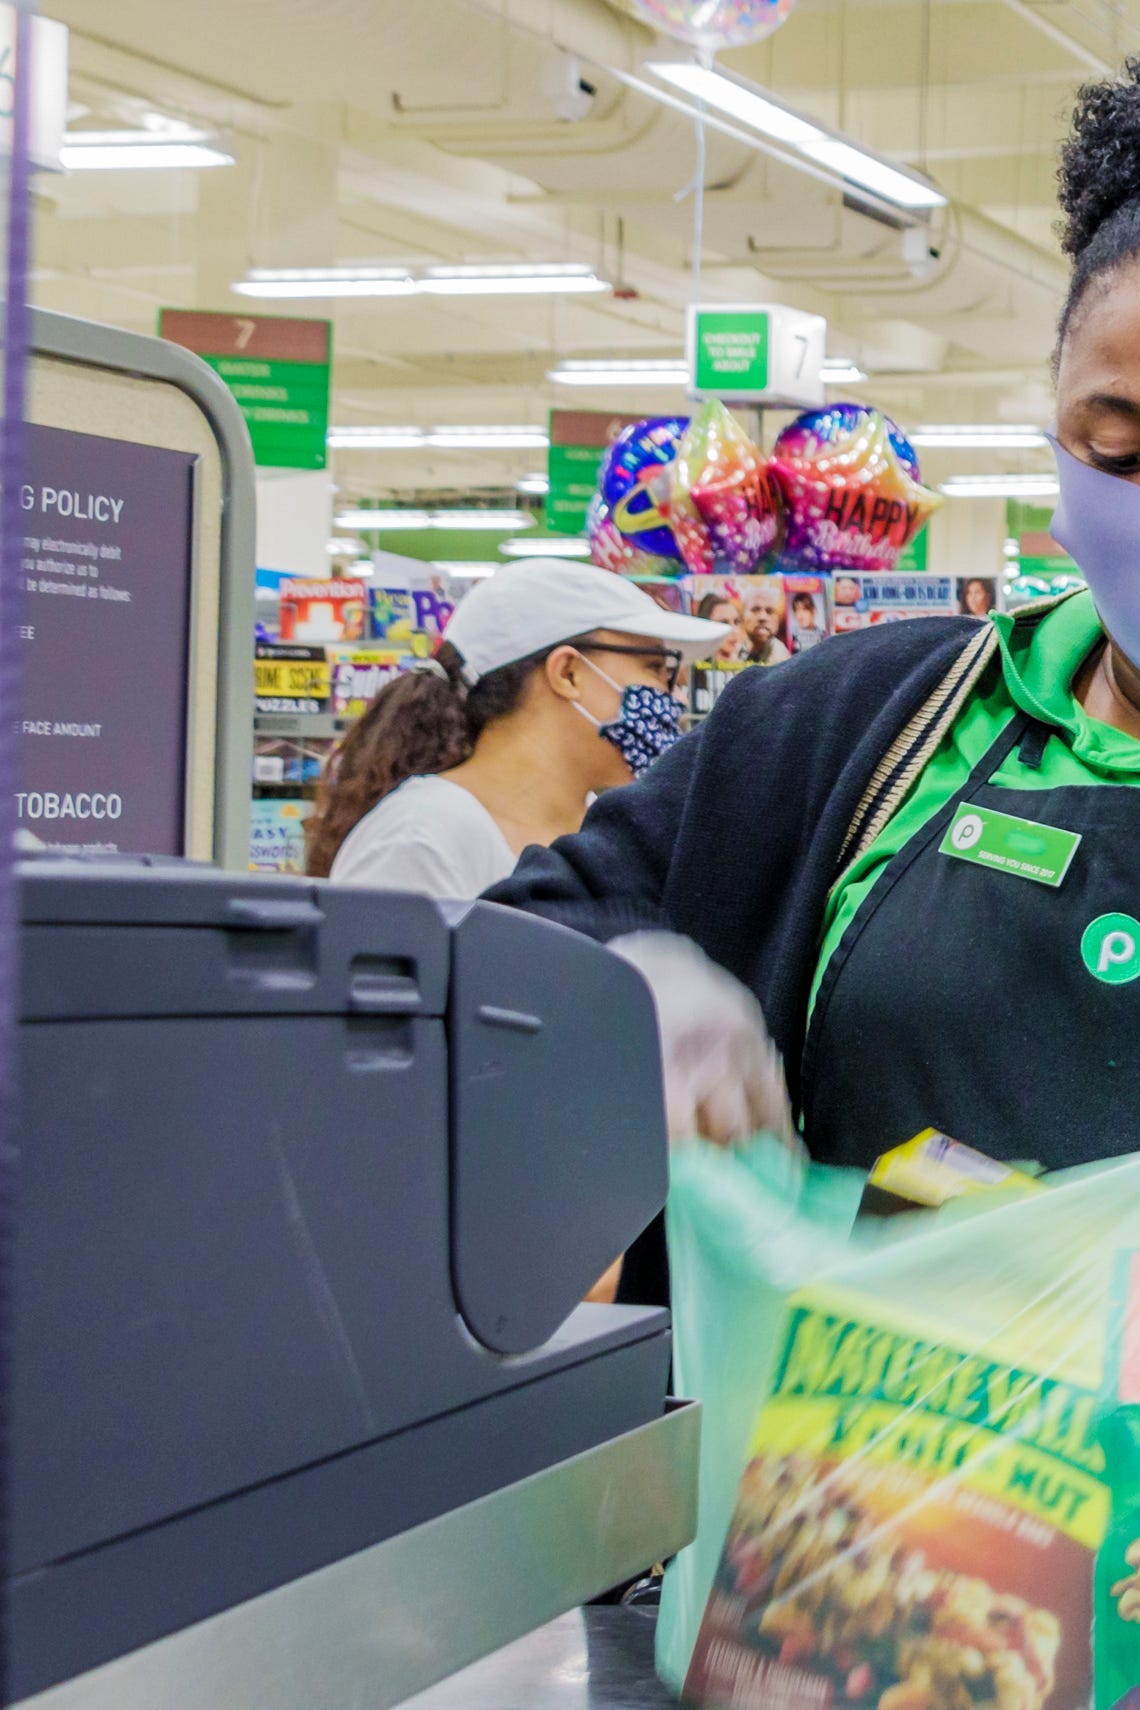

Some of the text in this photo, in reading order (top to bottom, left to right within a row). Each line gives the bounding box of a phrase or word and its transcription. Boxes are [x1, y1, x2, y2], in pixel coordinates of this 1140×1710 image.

[234, 319, 257, 349] 7
[793, 334, 809, 380] 7
[41, 486, 124, 524] POLICY
[825, 487, 920, 548] HAPPY
[281, 580, 365, 599] Prevention
[22, 720, 52, 736] FACE
[53, 722, 103, 738] AMOUNT
[13, 791, 122, 820] TOBACCO
[977, 850, 1007, 865] SERVING
[1006, 857, 1022, 869] YOU
[1020, 861, 1041, 875] SINCE
[1003, 1458, 1089, 1524] NUT
